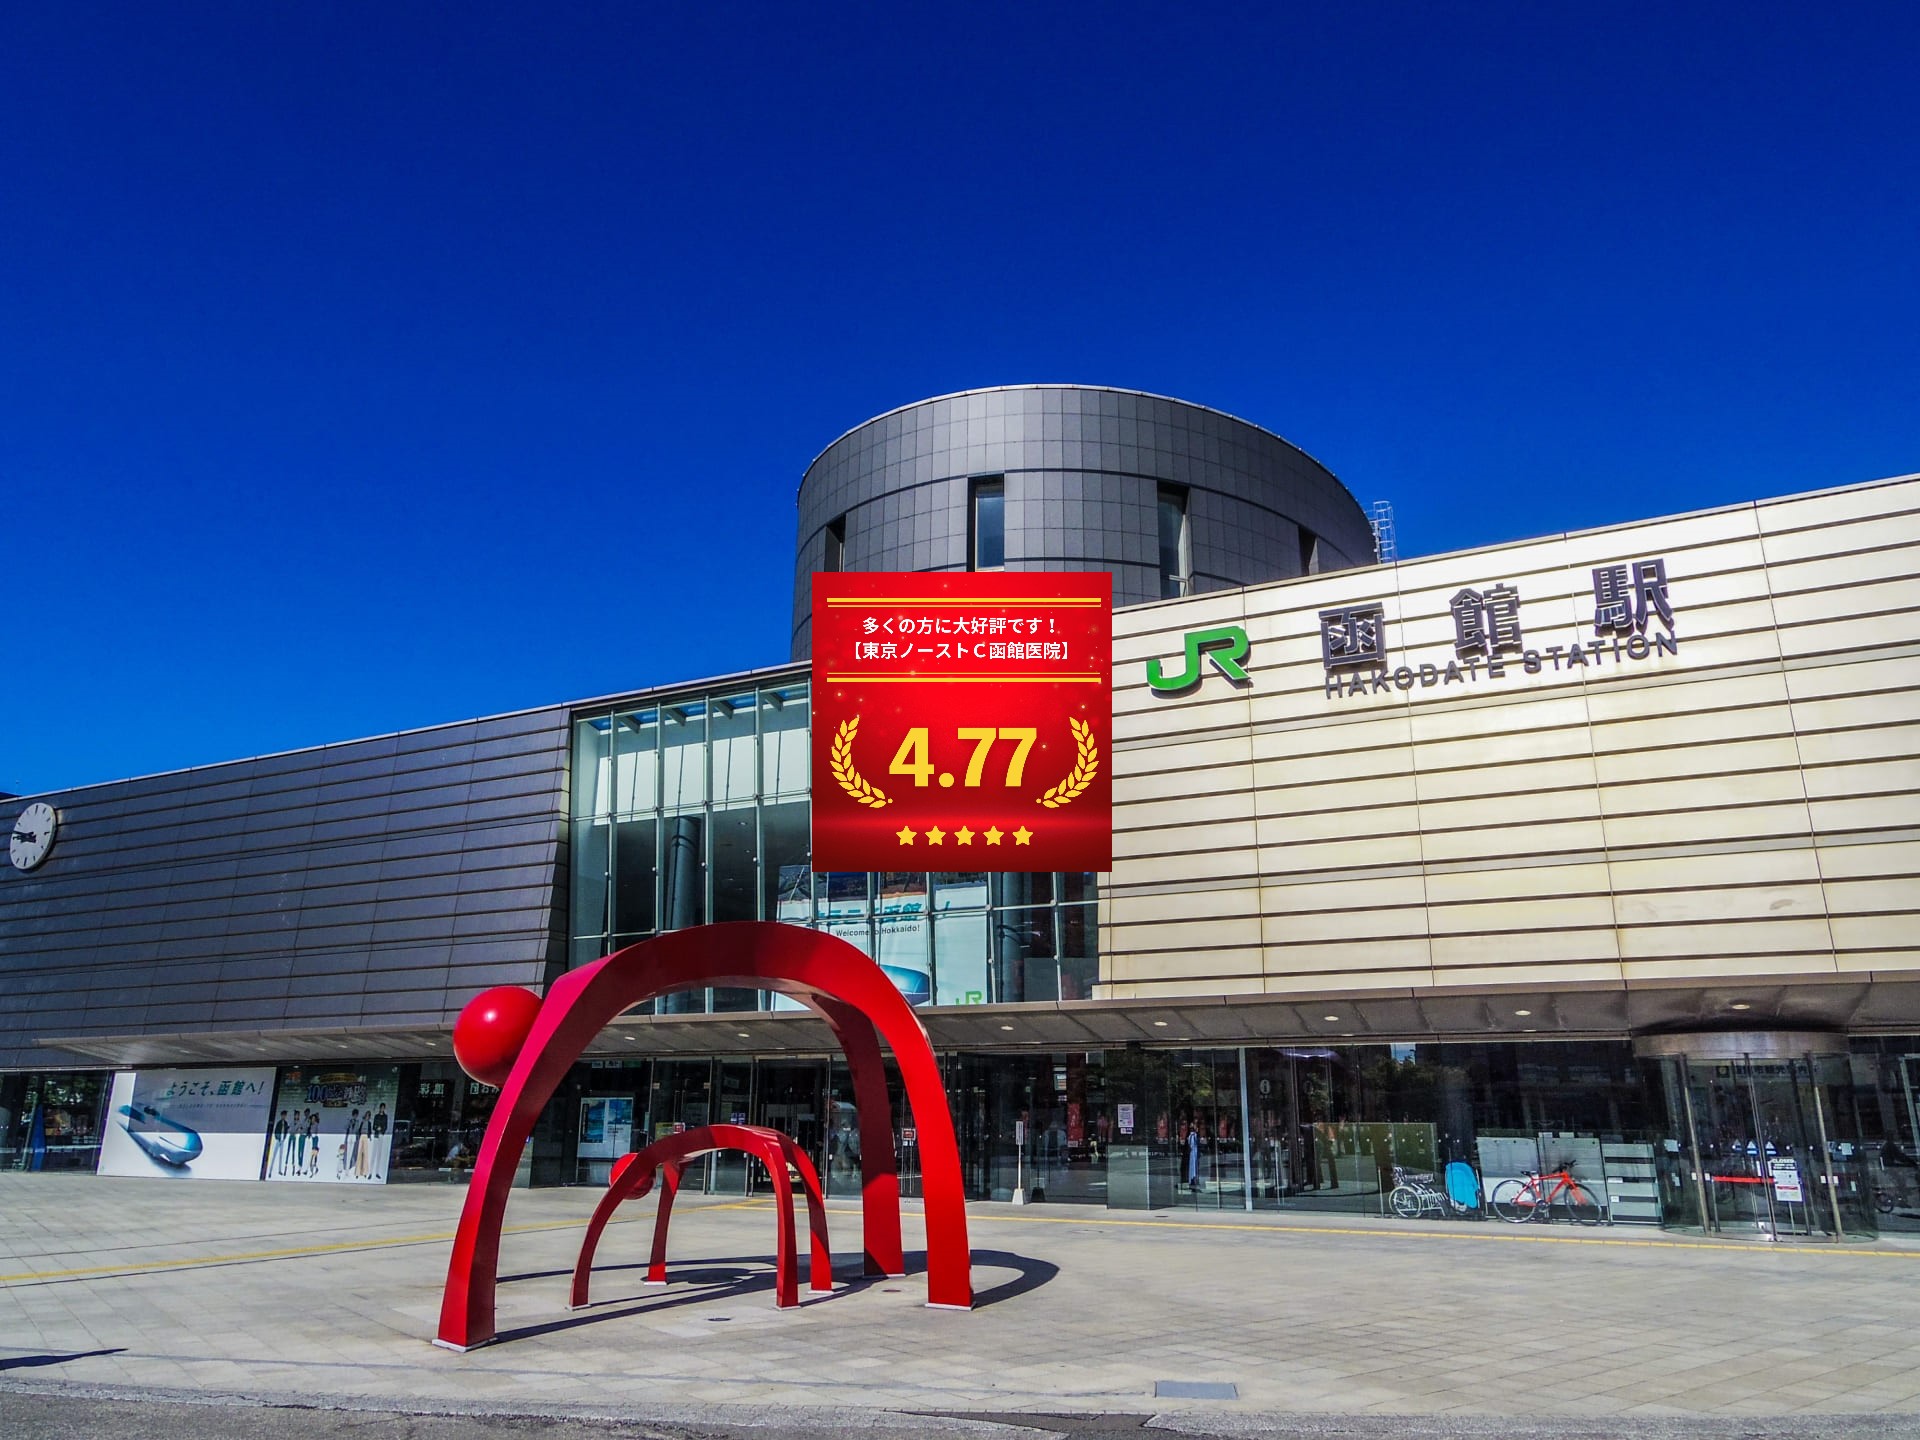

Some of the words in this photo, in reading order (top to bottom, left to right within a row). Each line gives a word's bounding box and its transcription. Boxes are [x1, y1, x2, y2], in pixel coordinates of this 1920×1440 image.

[1318, 558, 1674, 669] 函館駅
[1146, 625, 1252, 692] JR
[1325, 655, 1505, 699] HAKODATE
[1524, 631, 1678, 674] STATION
[836, 928, 870, 937] Welcome
[881, 924, 920, 935] Hokkaido!
